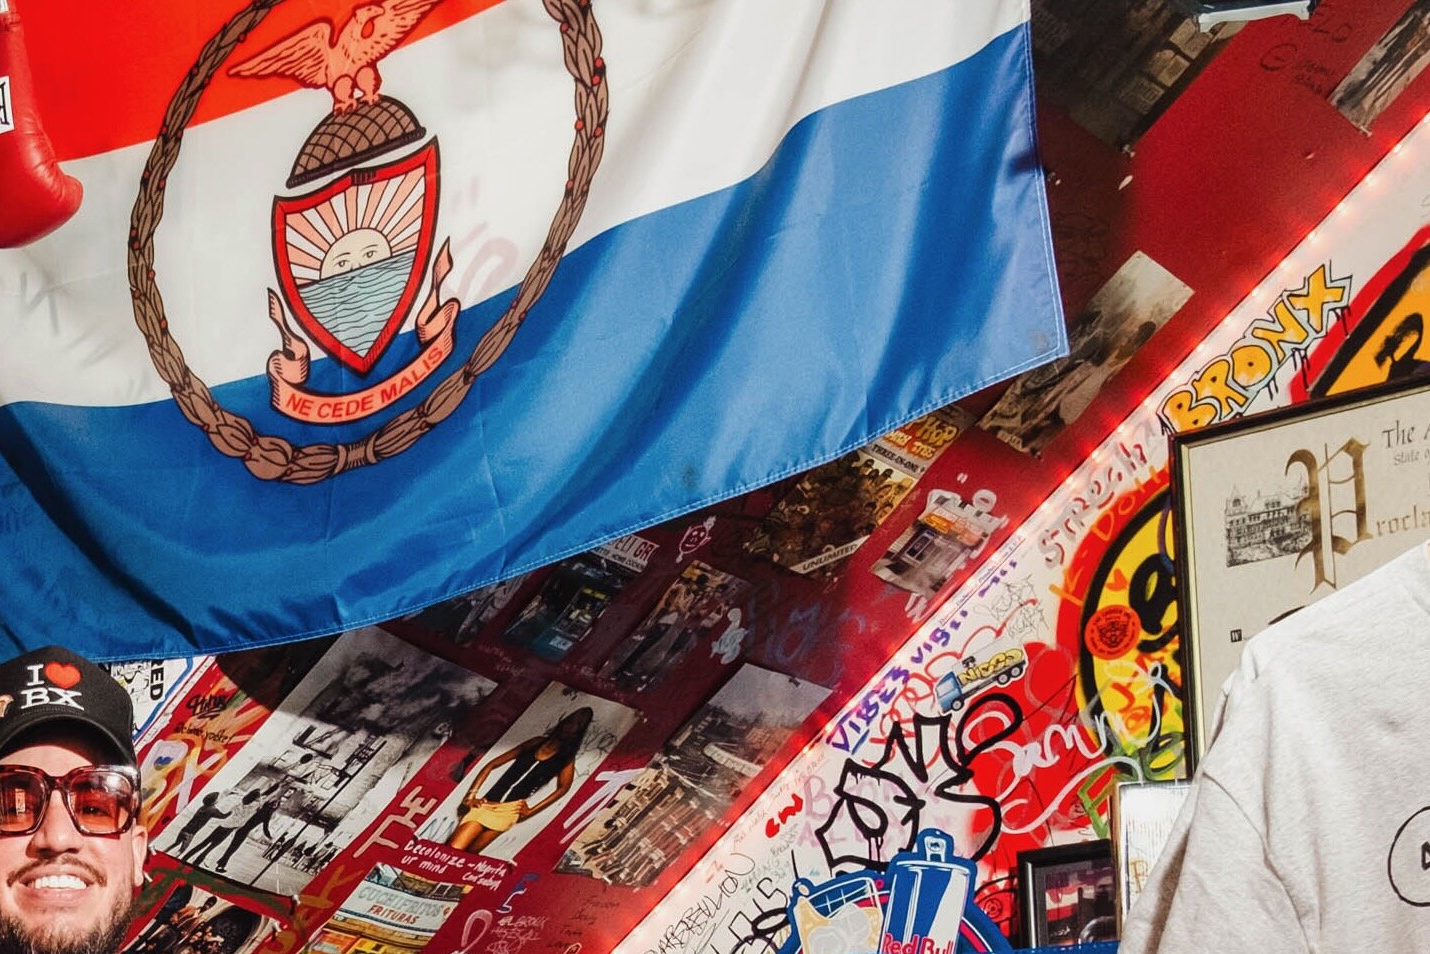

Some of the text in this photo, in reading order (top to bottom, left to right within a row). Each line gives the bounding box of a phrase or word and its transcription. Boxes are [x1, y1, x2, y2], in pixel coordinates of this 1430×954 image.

[1161, 264, 1353, 433] BRONX
[285, 347, 443, 419] NE CEDE MALIS
[1382, 420, 1415, 448] The
[27, 664, 44, 687] I
[20, 689, 86, 712] BX
[403, 840, 465, 868] Decolonize
[418, 858, 447, 875] mind
[369, 904, 420, 926] FRITURAS
